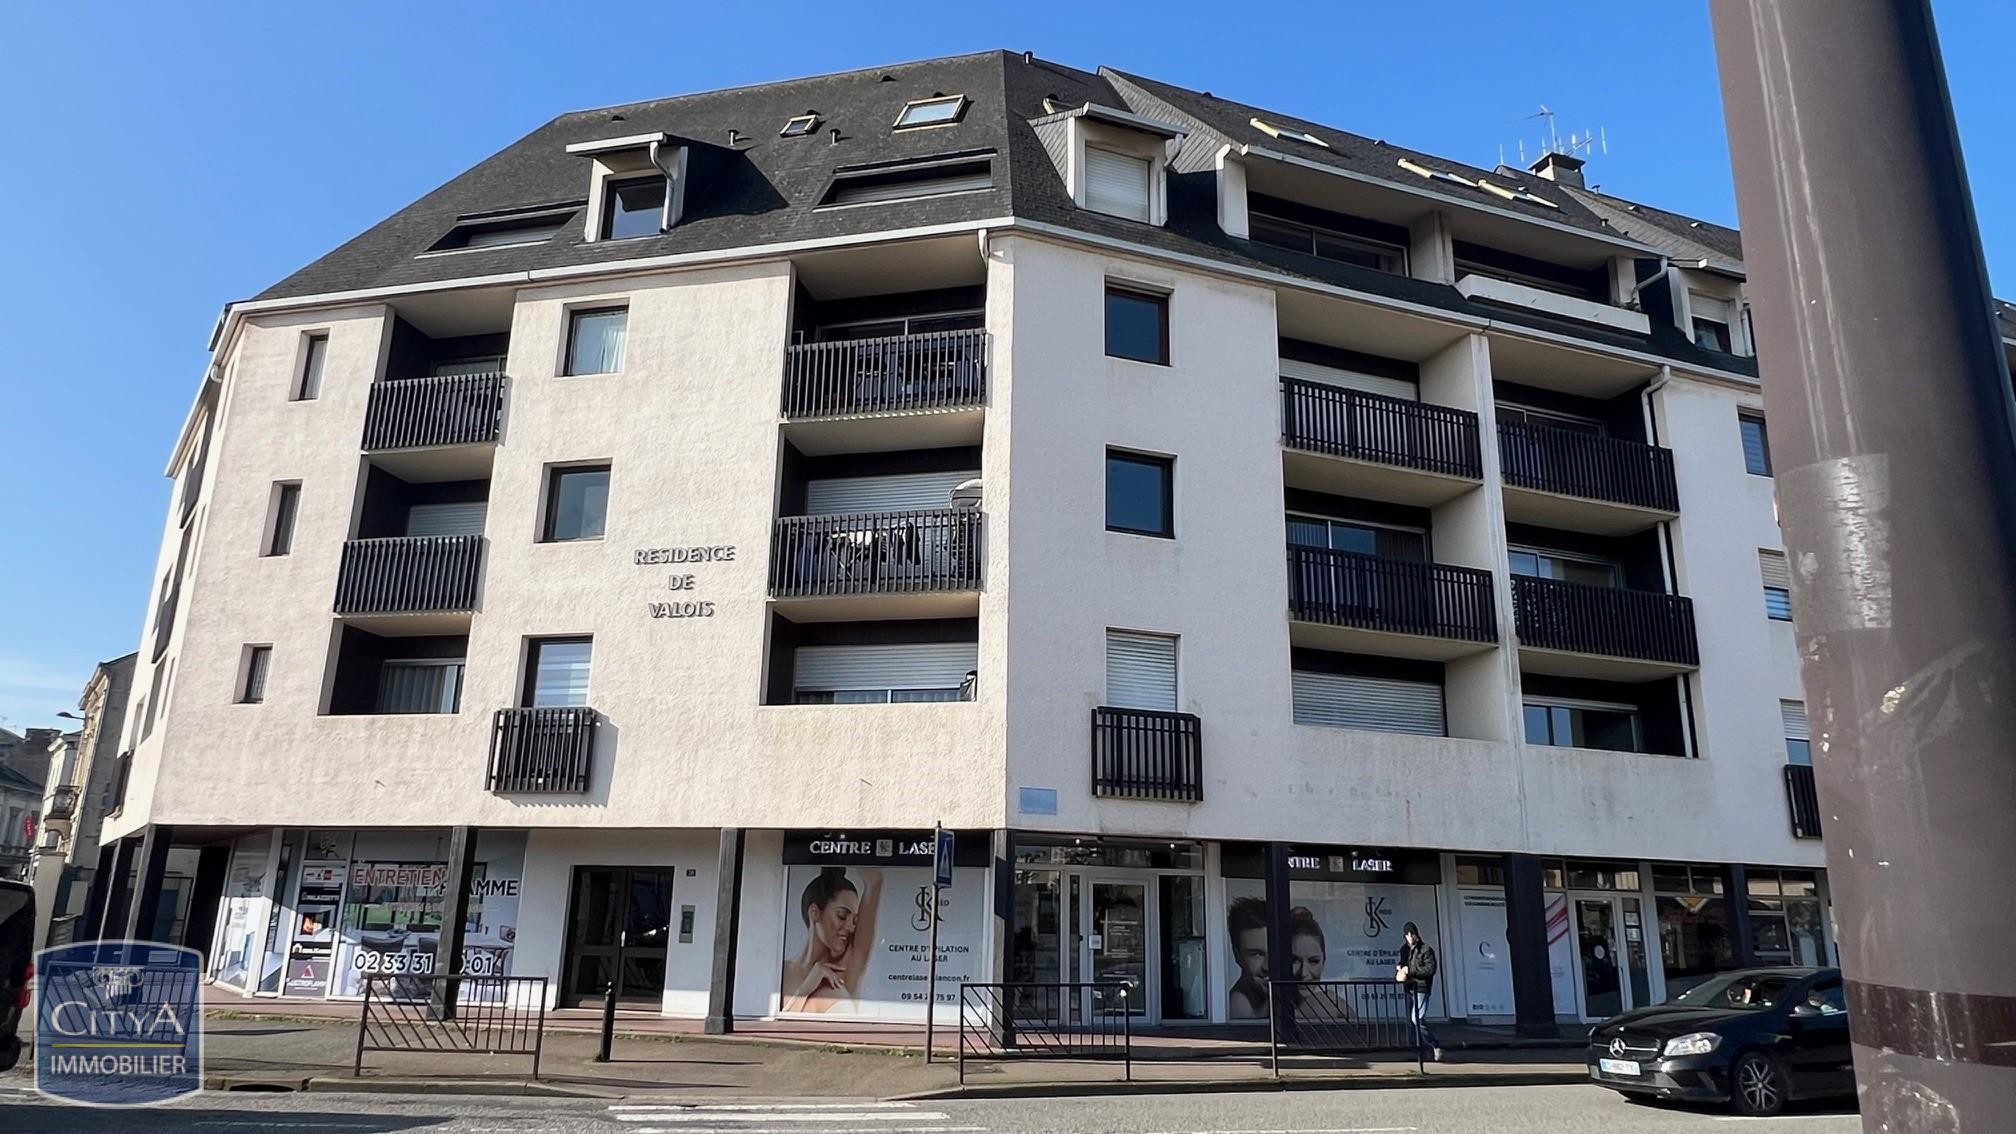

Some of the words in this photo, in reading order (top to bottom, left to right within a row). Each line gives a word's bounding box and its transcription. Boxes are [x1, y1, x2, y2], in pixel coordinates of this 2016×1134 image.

[634, 545, 736, 564] RESIDENCE
[668, 574, 696, 590] DE
[648, 601, 715, 618] VALOIS
[809, 840, 872, 854] CENTRE
[899, 841, 935, 855] LASE
[1352, 858, 1394, 872] LASER
[353, 868, 447, 885] ENTRETIEN
[888, 944, 919, 953] CENTRE
[355, 953, 378, 971] 02
[384, 954, 406, 972] 33
[413, 955, 432, 973] 31
[911, 954, 922, 962] AU
